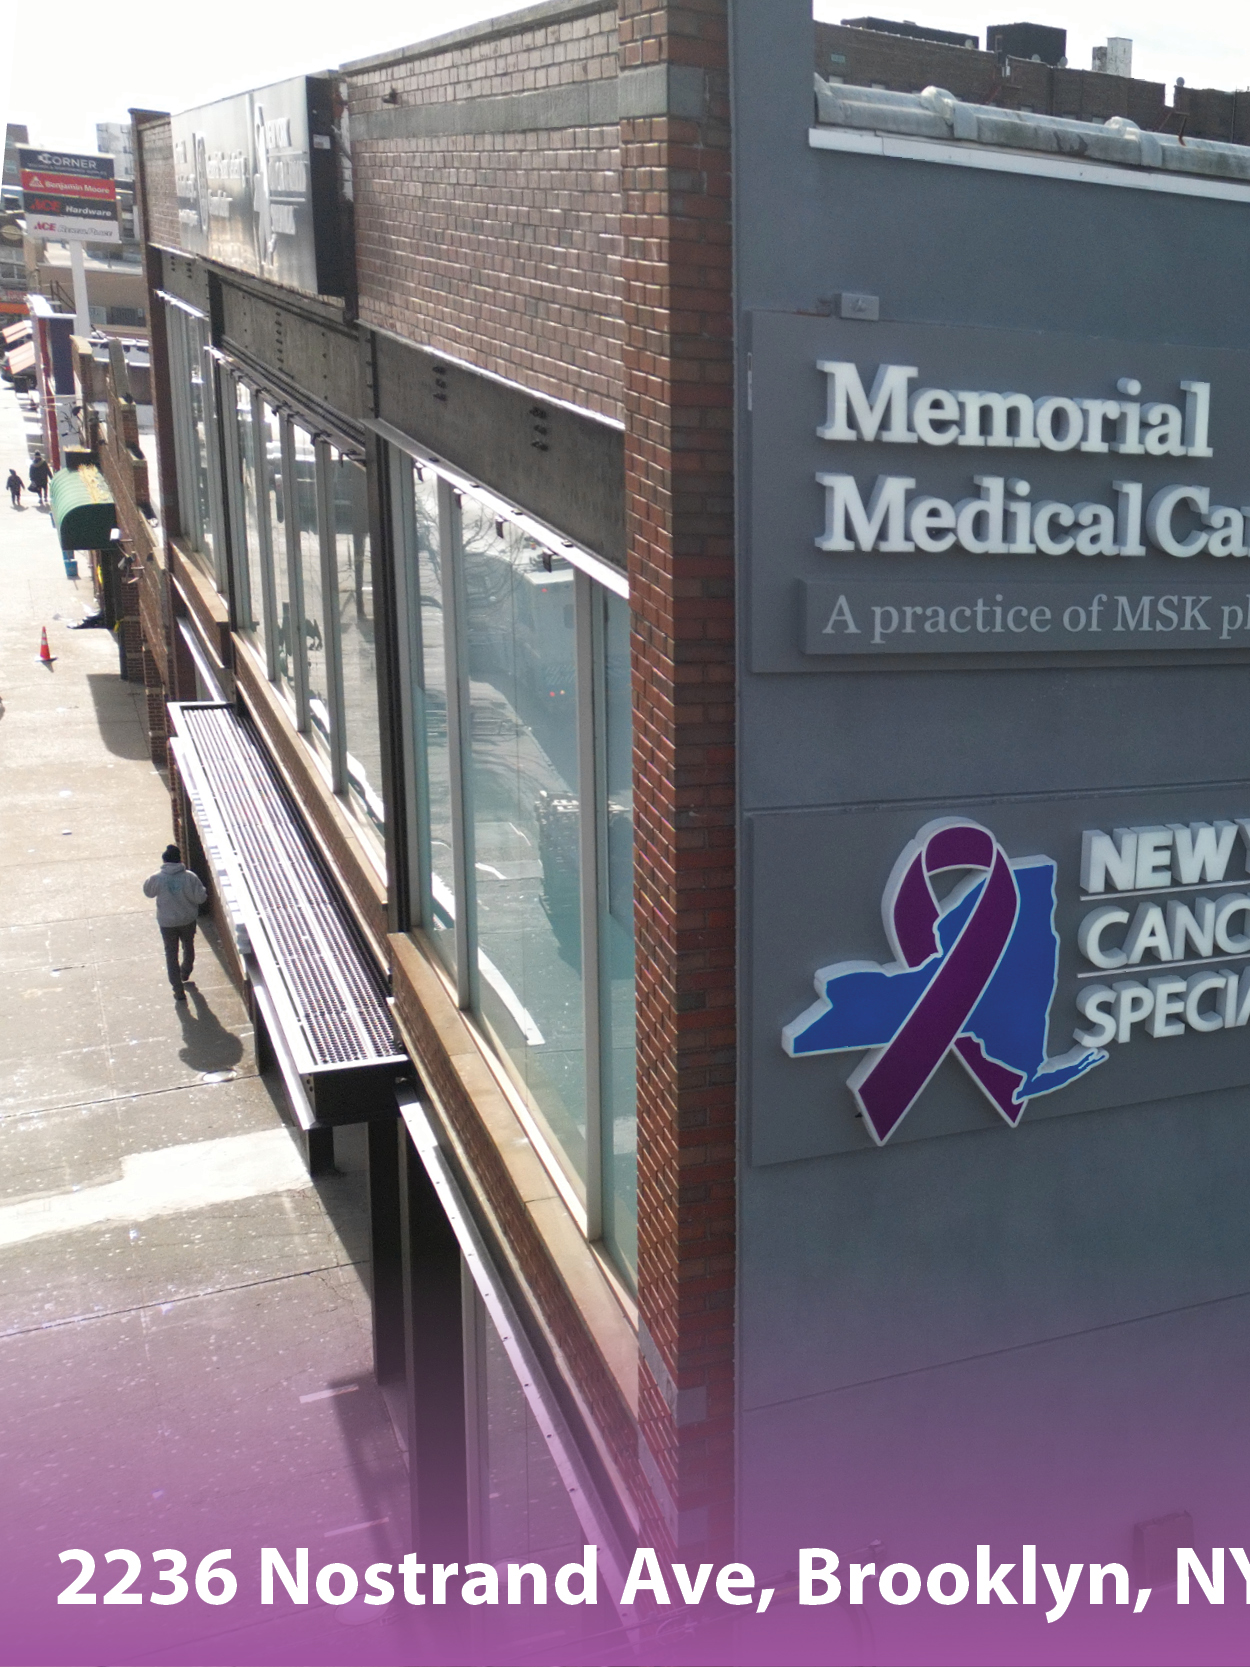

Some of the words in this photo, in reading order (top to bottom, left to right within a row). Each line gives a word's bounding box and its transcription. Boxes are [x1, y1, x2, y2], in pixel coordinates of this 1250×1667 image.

[38, 153, 97, 169] CORNER
[45, 181, 83, 191] Benjamin
[84, 184, 110, 194] Moore
[30, 198, 61, 213] ACE
[65, 205, 112, 217] Hardware
[34, 221, 57, 232] ACE
[816, 359, 1213, 458] Memorial
[815, 472, 1146, 557] Medical
[822, 595, 861, 634] A
[871, 595, 1051, 643] practice
[1064, 594, 1108, 633] of
[1113, 596, 1208, 633] MSK
[1080, 820, 1238, 893] NEW
